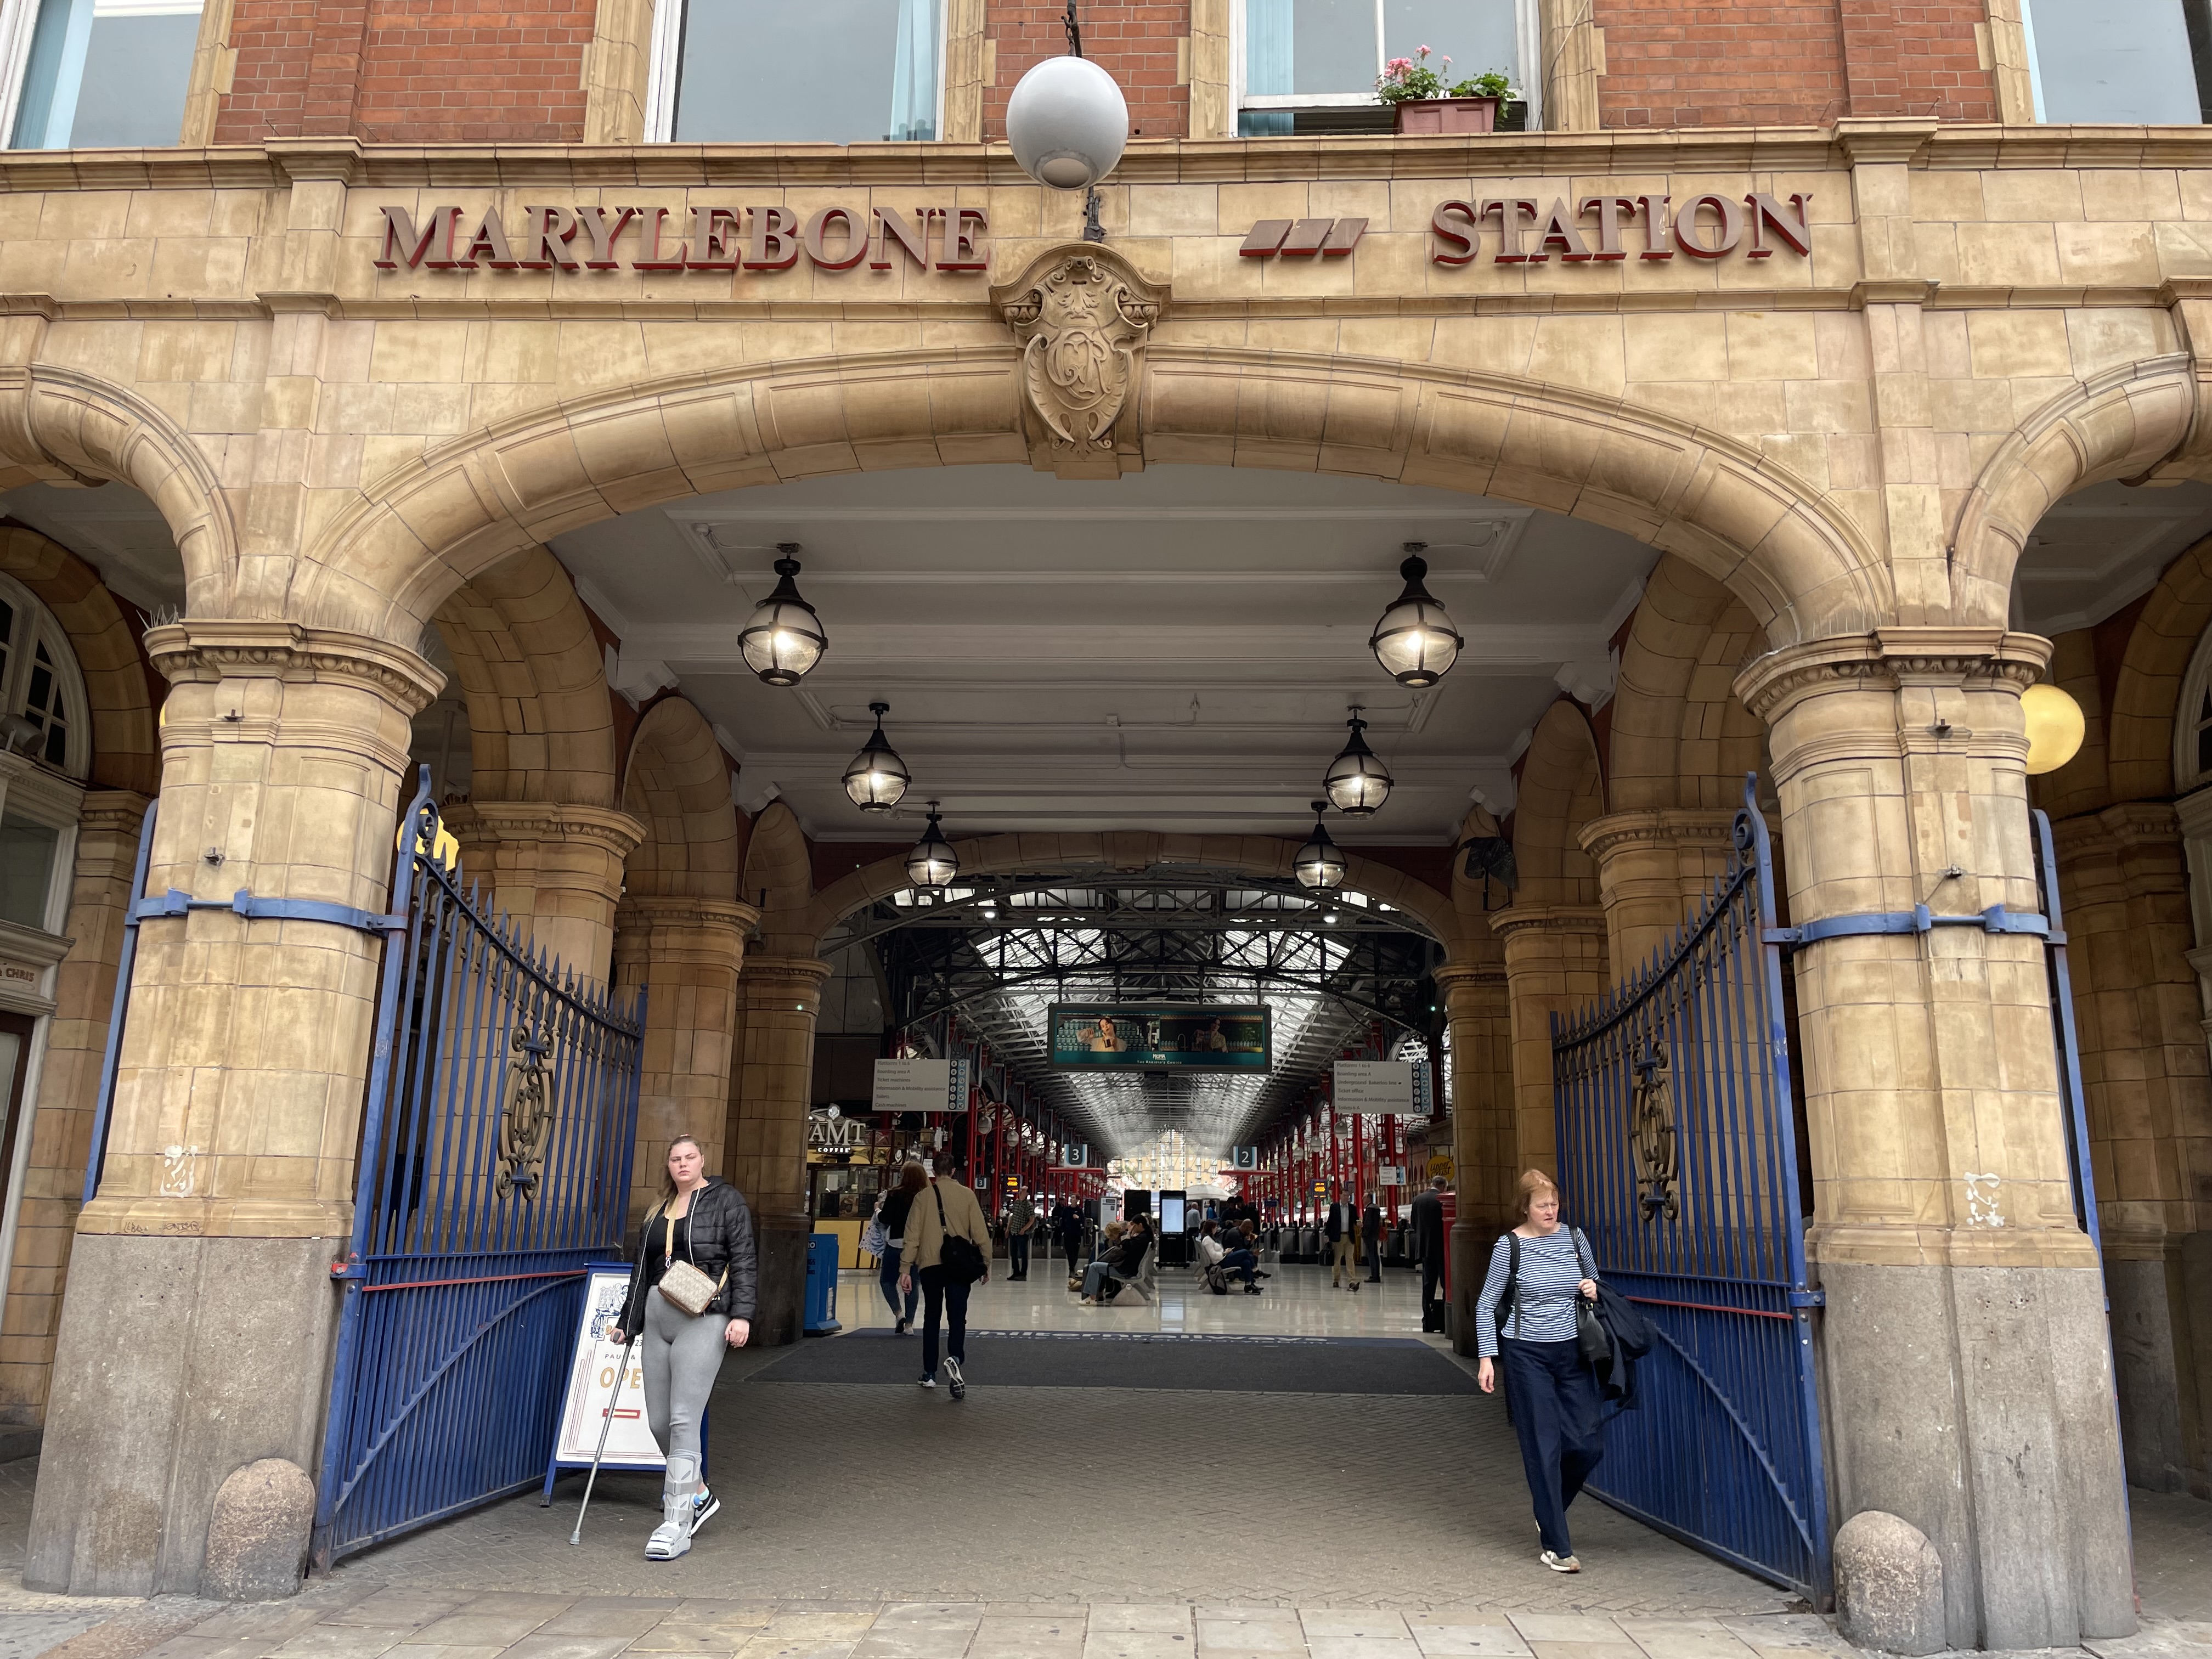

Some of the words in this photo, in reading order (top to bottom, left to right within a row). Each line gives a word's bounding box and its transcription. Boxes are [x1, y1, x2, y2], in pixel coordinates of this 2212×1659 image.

[373, 205, 990, 271] MARYLEBONE
[1432, 193, 1814, 266] STATION
[6, 967, 35, 982] CHRIS
[809, 1119, 866, 1146] AMT
[1071, 1149, 1080, 1161] 3
[1242, 1151, 1249, 1164] 2
[871, 1223, 884, 1256] Welcom
[600, 1367, 643, 1389] OPE
